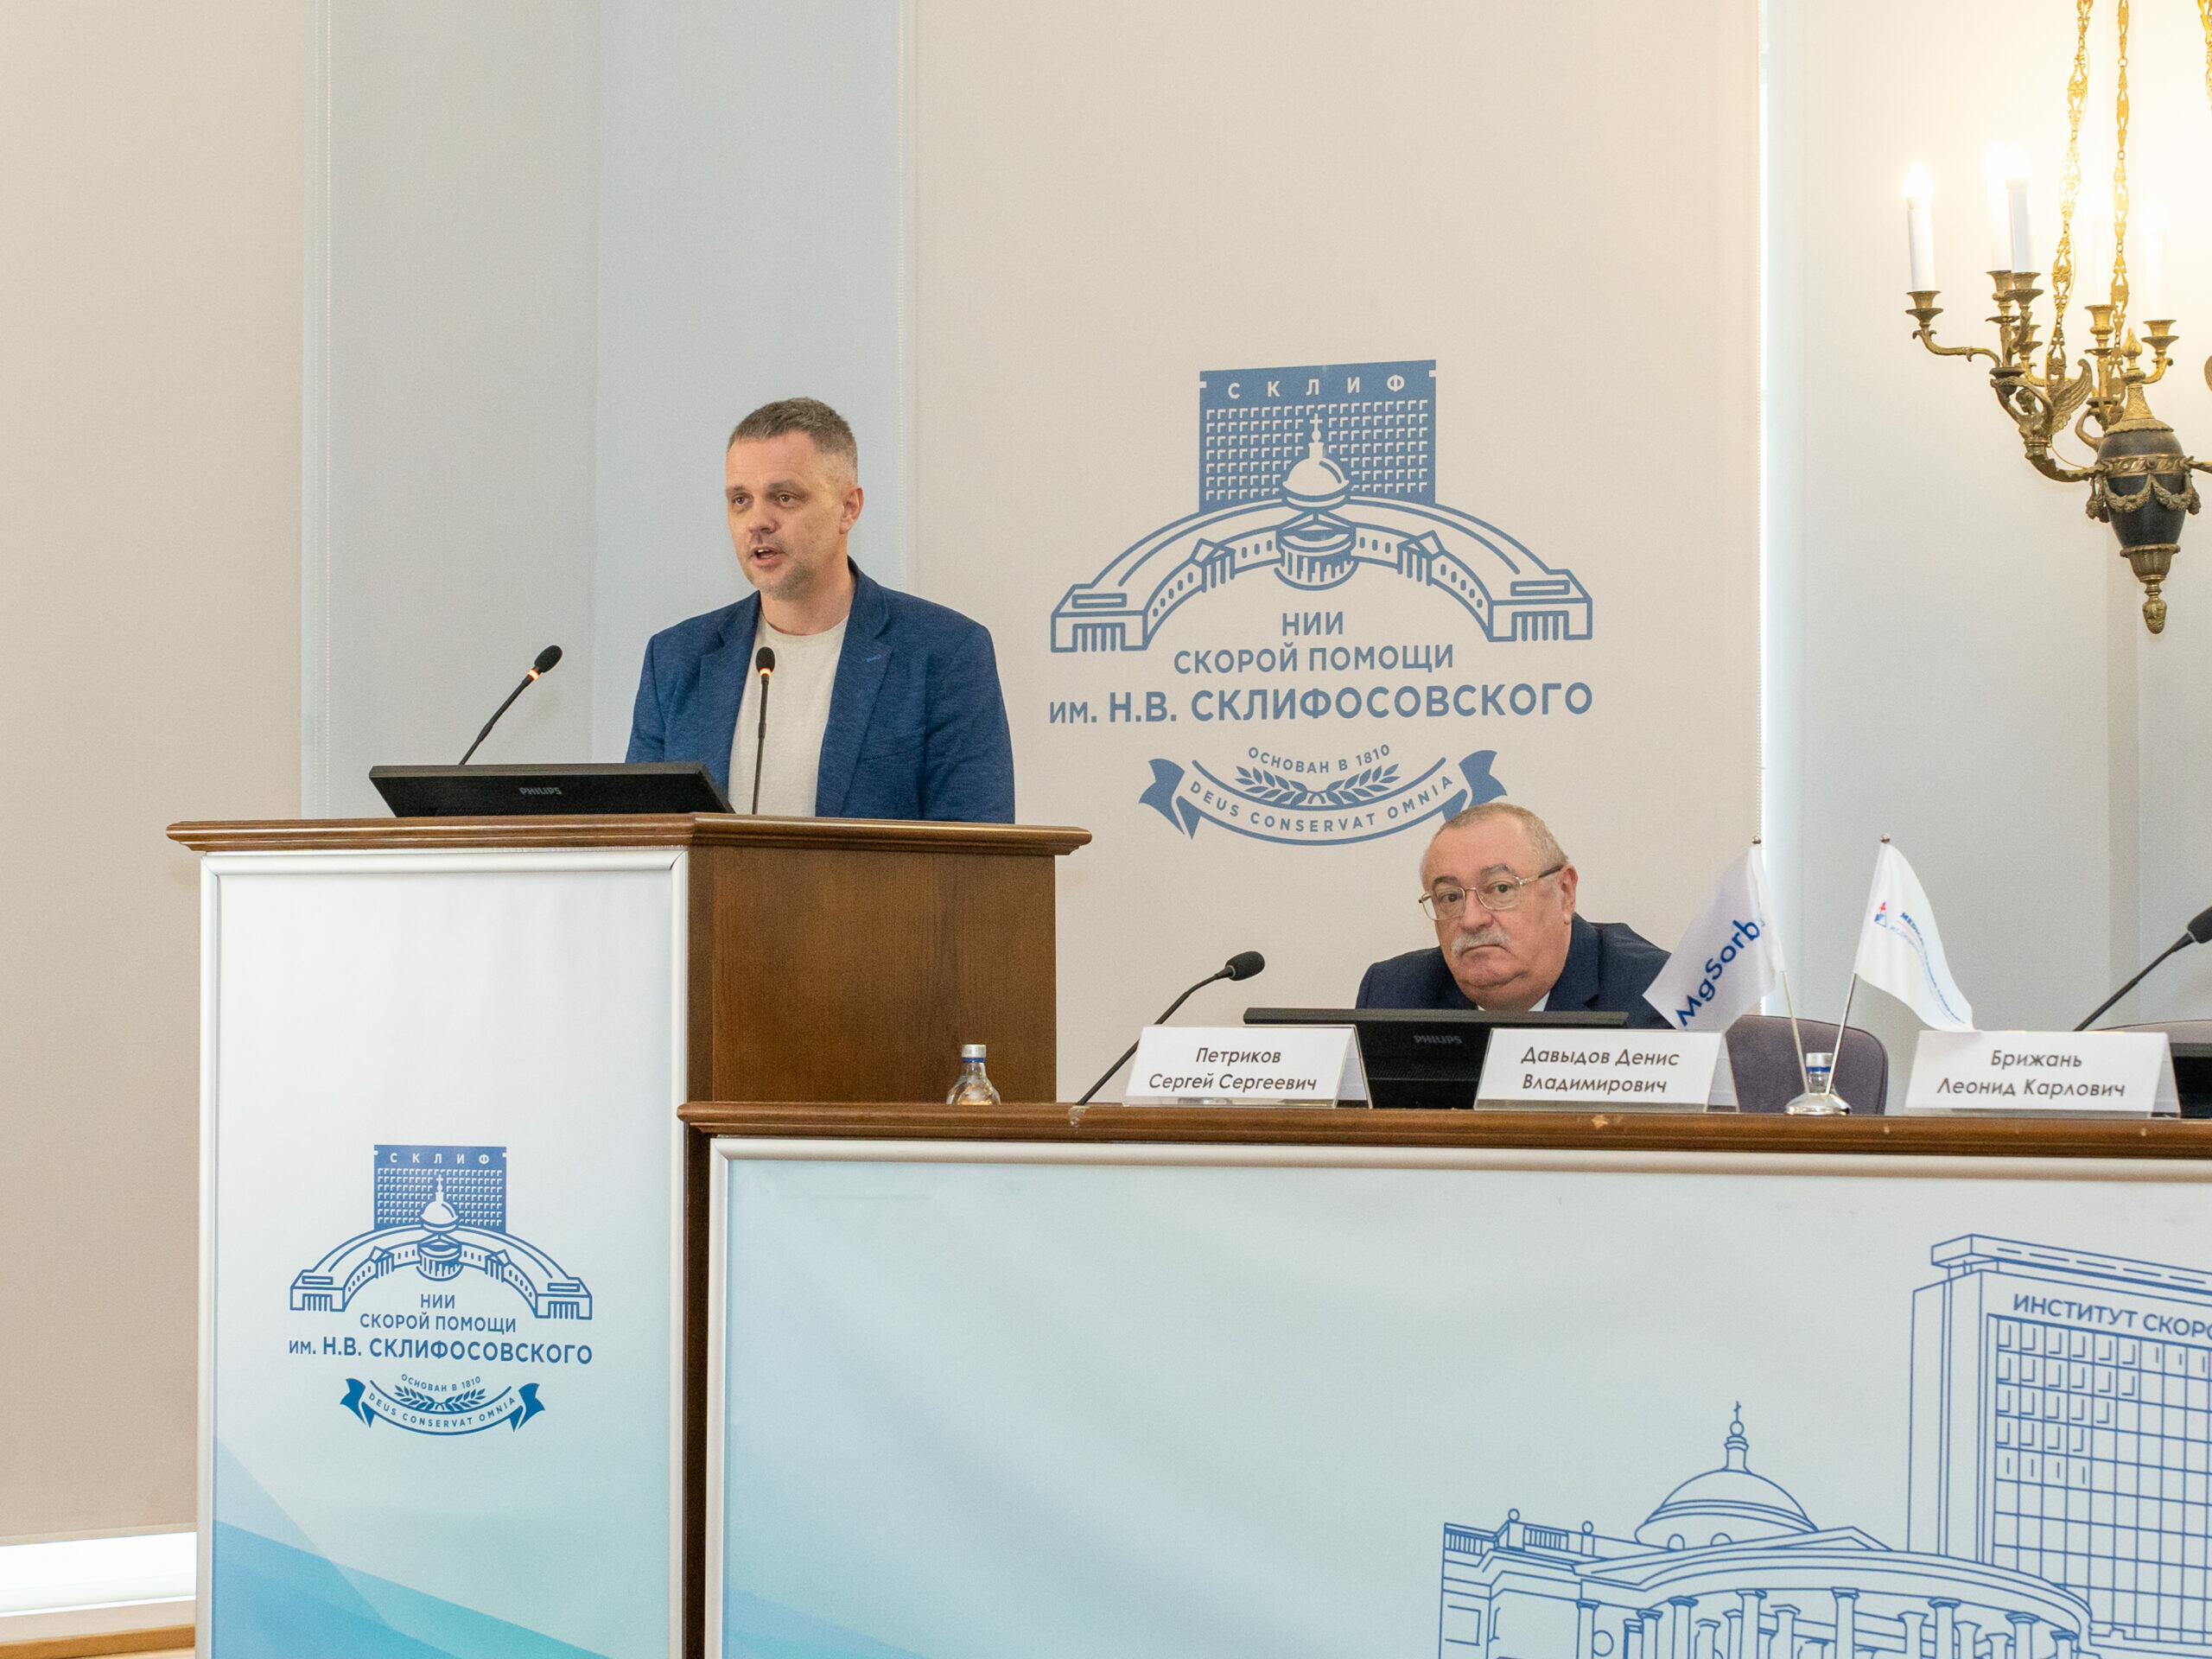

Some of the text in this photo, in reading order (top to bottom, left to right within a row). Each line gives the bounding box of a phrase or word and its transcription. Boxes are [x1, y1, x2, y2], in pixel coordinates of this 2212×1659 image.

[1282, 611, 1344, 636] НИИ
[1173, 641, 1453, 675] СКОРОЙ ПОМОЩИ
[1109, 690, 1177, 723] Н.В.
[1191, 682, 1592, 721] СКЛИФОСОВСКОГО
[1249, 744, 1390, 773] ОСНОВАН В 1810
[518, 786, 563, 795] PHILIPS
[1190, 776, 1453, 832] DEUS CONSERVAT OMNIA
[1675, 919, 1760, 1027] MgSorb
[1413, 1034, 1463, 1045] PHILIPS
[1195, 1047, 1281, 1067] Петриков
[1520, 1046, 1680, 1067] Давыдов Денис
[1991, 1050, 2082, 1070] Брижань
[1148, 1072, 1317, 1093] Сергей Сергеевич
[1522, 1073, 1667, 1096] Владимирович
[1936, 1077, 2126, 1099] Леонид Карлович
[420, 1294, 455, 1309] НИИ
[2013, 1294, 2139, 1328] ИНСТИТУТ
[359, 1312, 516, 1335] СКОРОЙ ПОМОЩИ
[323, 1337, 362, 1357] Н.В.
[369, 1338, 593, 1365] СКЛИФОСОВСКОГО
[401, 1374, 447, 1392] ОСНОВАН
[461, 1376, 481, 1389] 1810
[369, 1392, 516, 1427] DEUS CONSERVAT OMNIA
